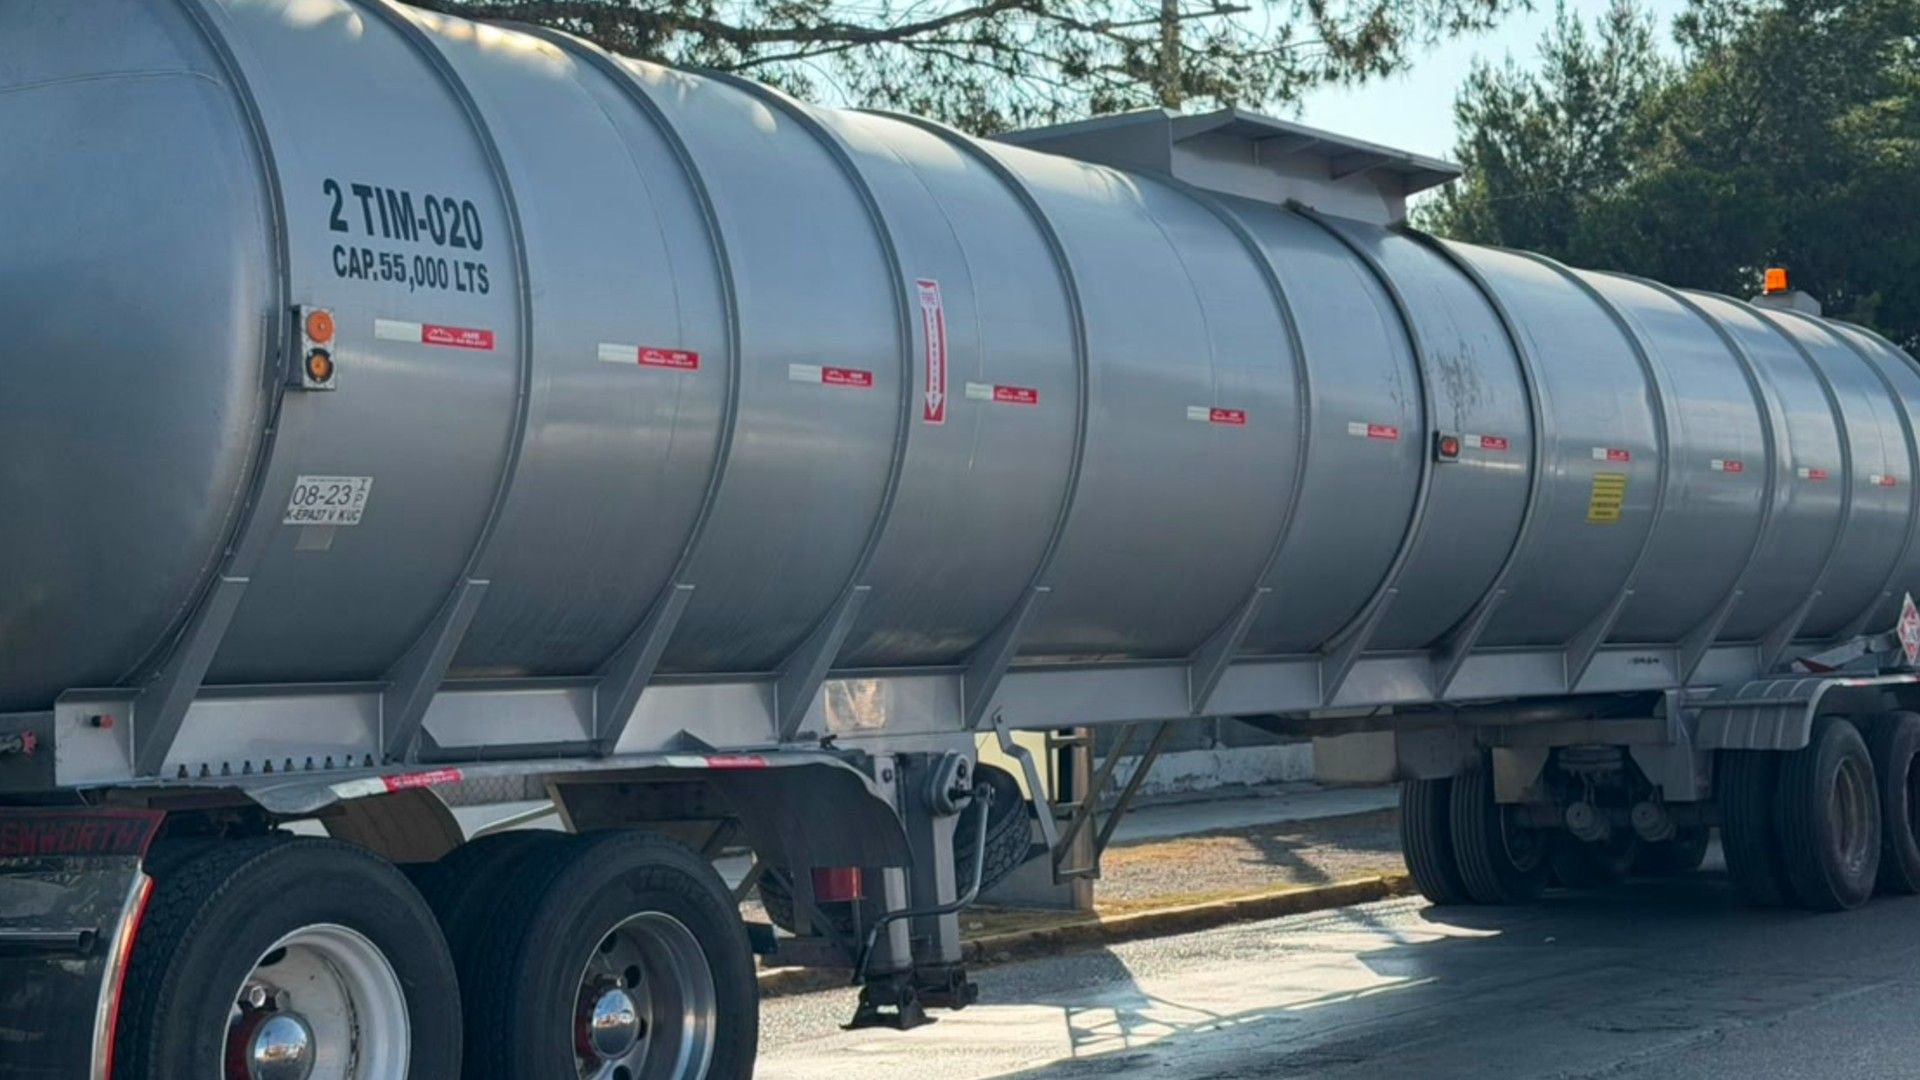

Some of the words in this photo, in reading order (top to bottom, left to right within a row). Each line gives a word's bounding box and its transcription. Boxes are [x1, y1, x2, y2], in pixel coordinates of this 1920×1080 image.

[323, 178, 349, 233] 2
[351, 183, 483, 251] TIM-020
[333, 244, 449, 293] CAP.55,000
[454, 259, 490, 295] LTS
[293, 485, 352, 506] 08-23
